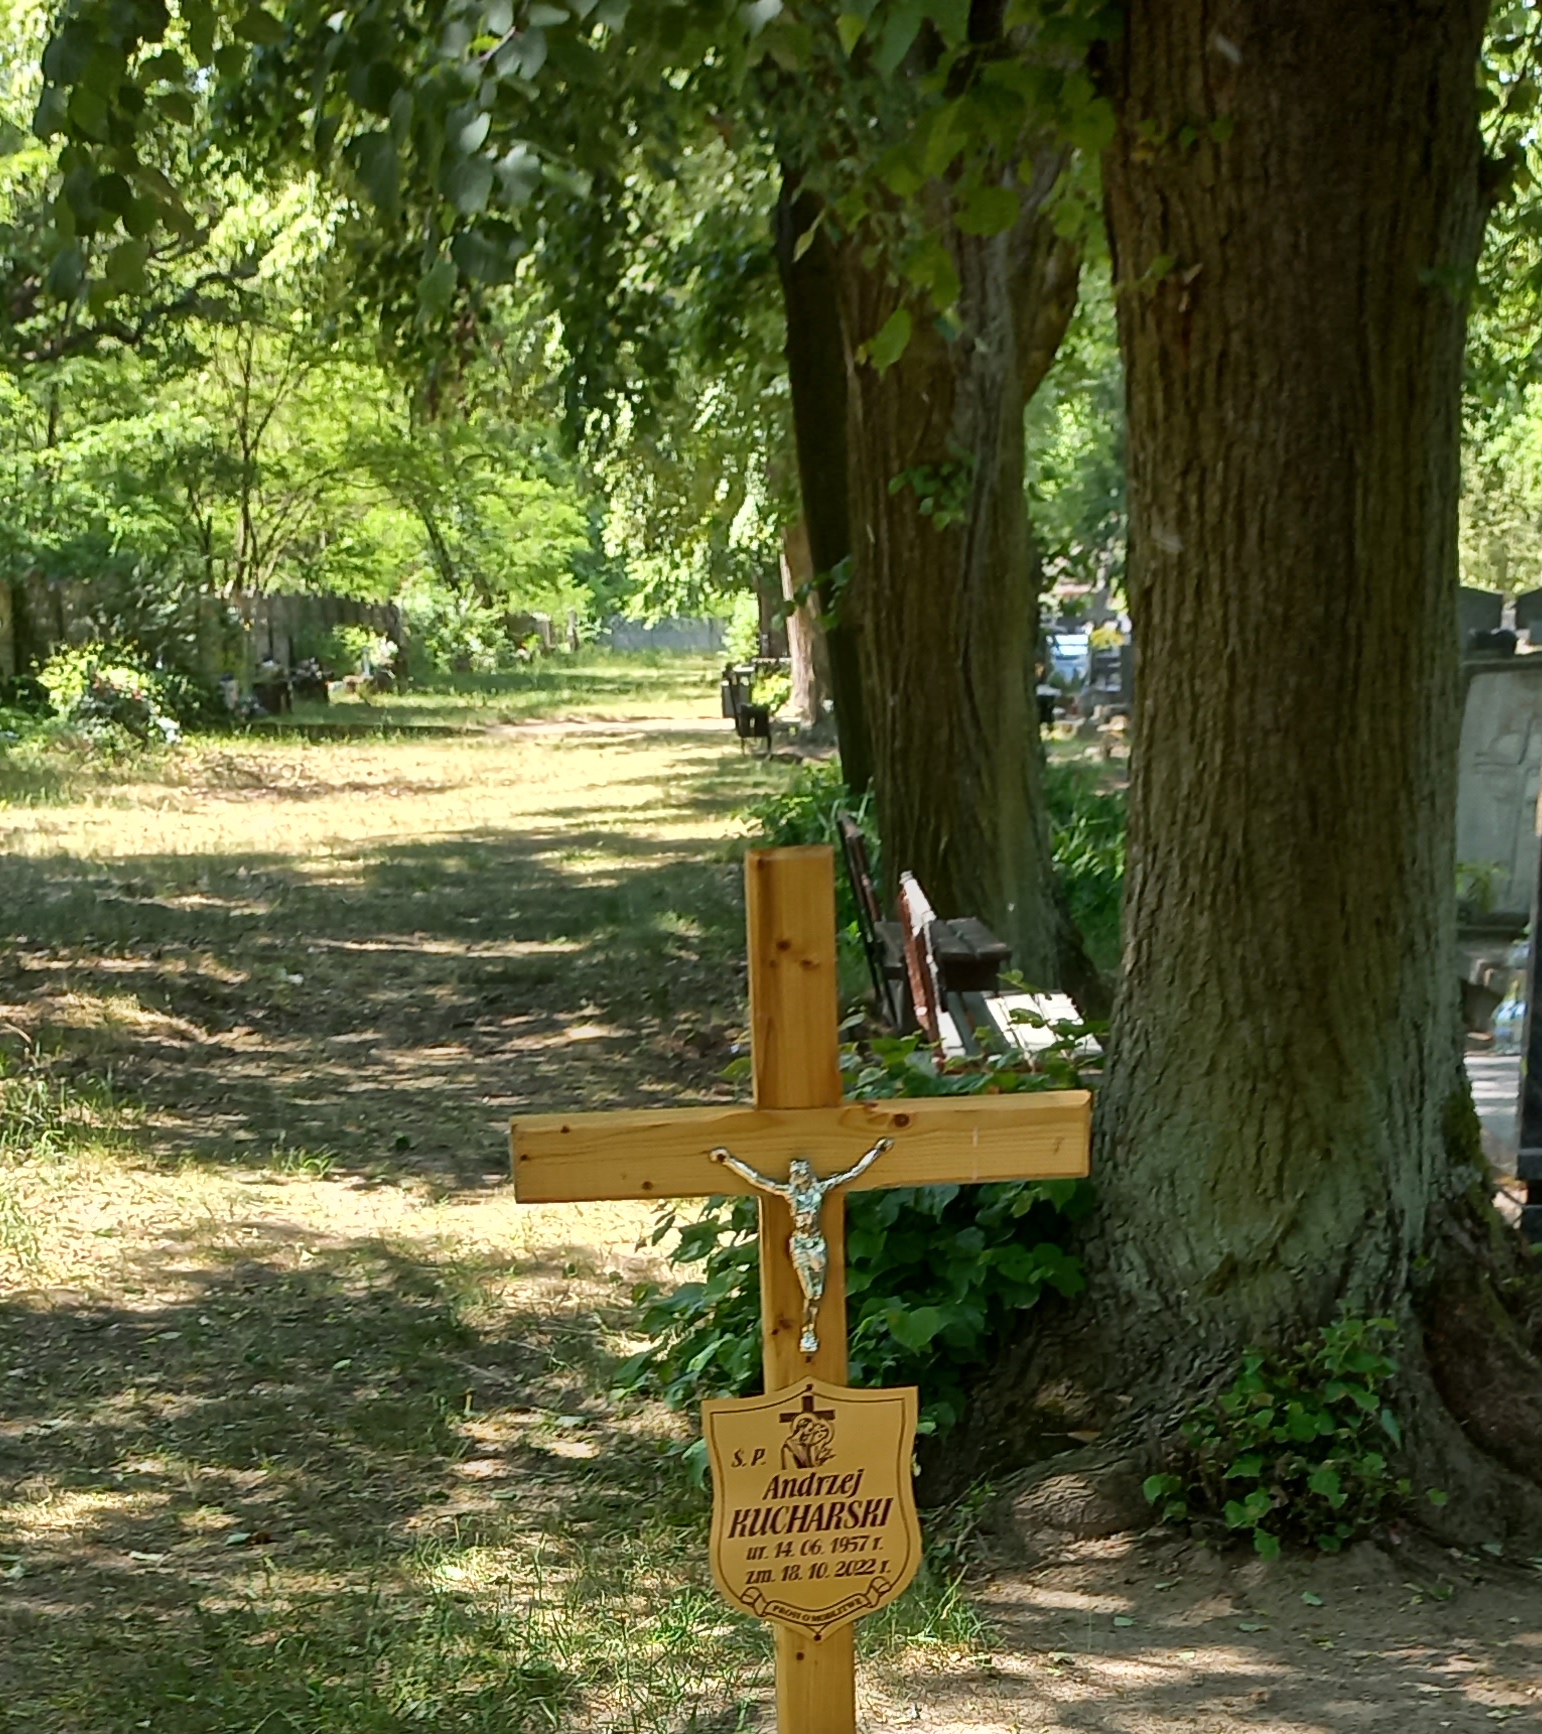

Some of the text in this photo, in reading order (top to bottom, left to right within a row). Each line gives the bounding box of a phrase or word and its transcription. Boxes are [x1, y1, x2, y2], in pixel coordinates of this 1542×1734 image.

[762, 1468, 865, 1500] Andrzej
[727, 1497, 894, 1539] KUCHARSKI
[745, 1545, 769, 1561] ur.
[774, 1540, 795, 1558] 14.
[830, 1535, 871, 1554] 1957
[745, 1569, 776, 1585] zm.
[808, 1561, 830, 1579] 10.
[834, 1558, 877, 1578] 2022
